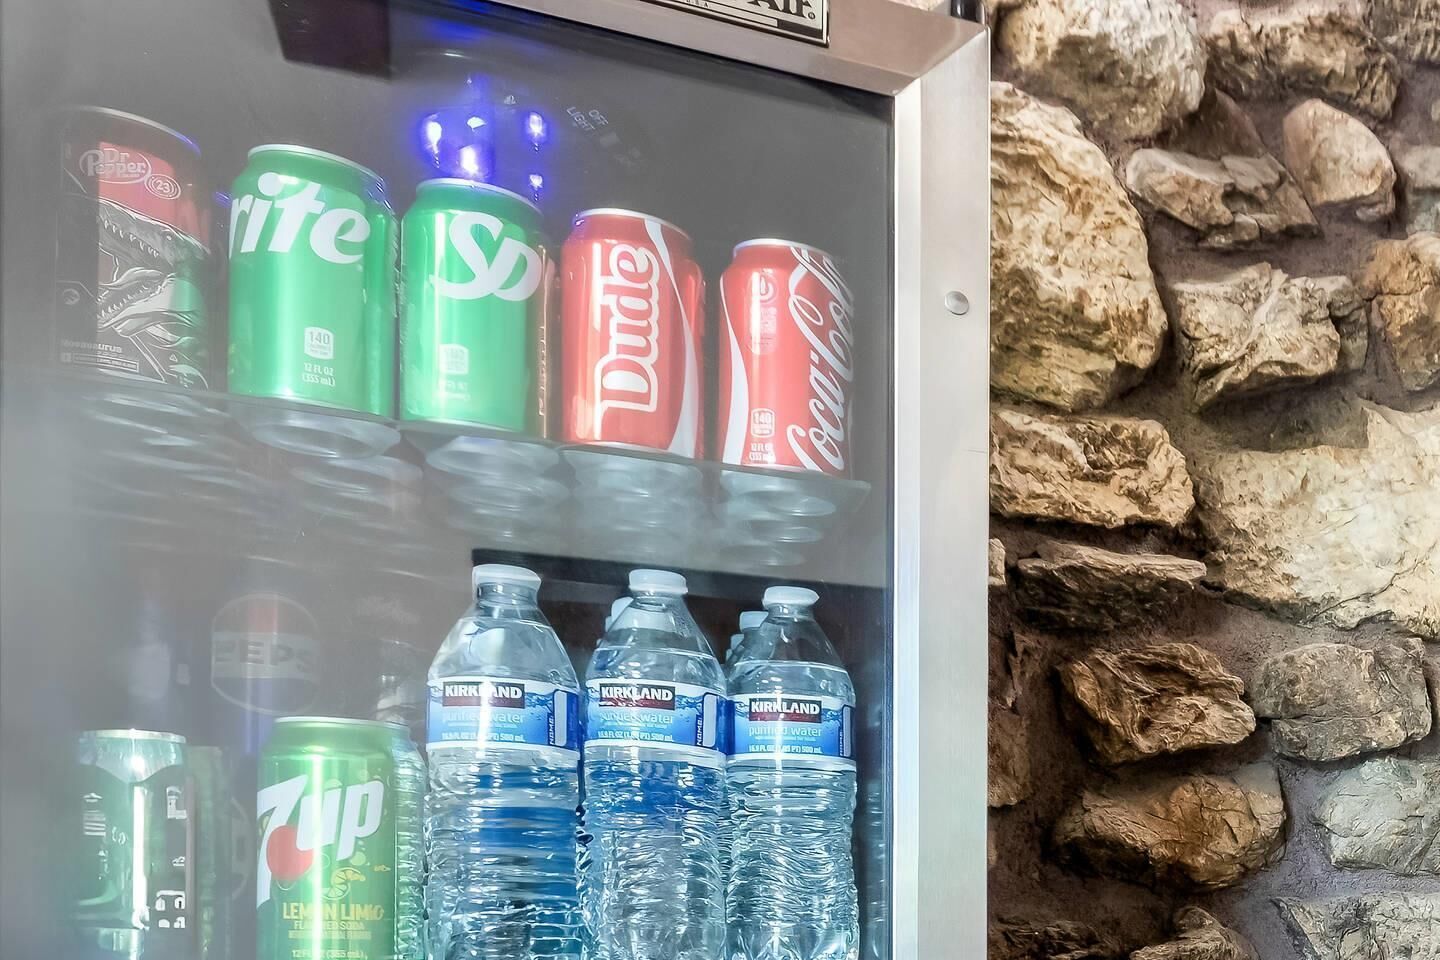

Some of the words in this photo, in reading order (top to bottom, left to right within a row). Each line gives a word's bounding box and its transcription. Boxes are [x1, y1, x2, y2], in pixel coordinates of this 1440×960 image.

[156, 180, 171, 194] 23
[600, 686, 673, 701] KIRKLAND
[751, 701, 820, 715] KIRKLAND
